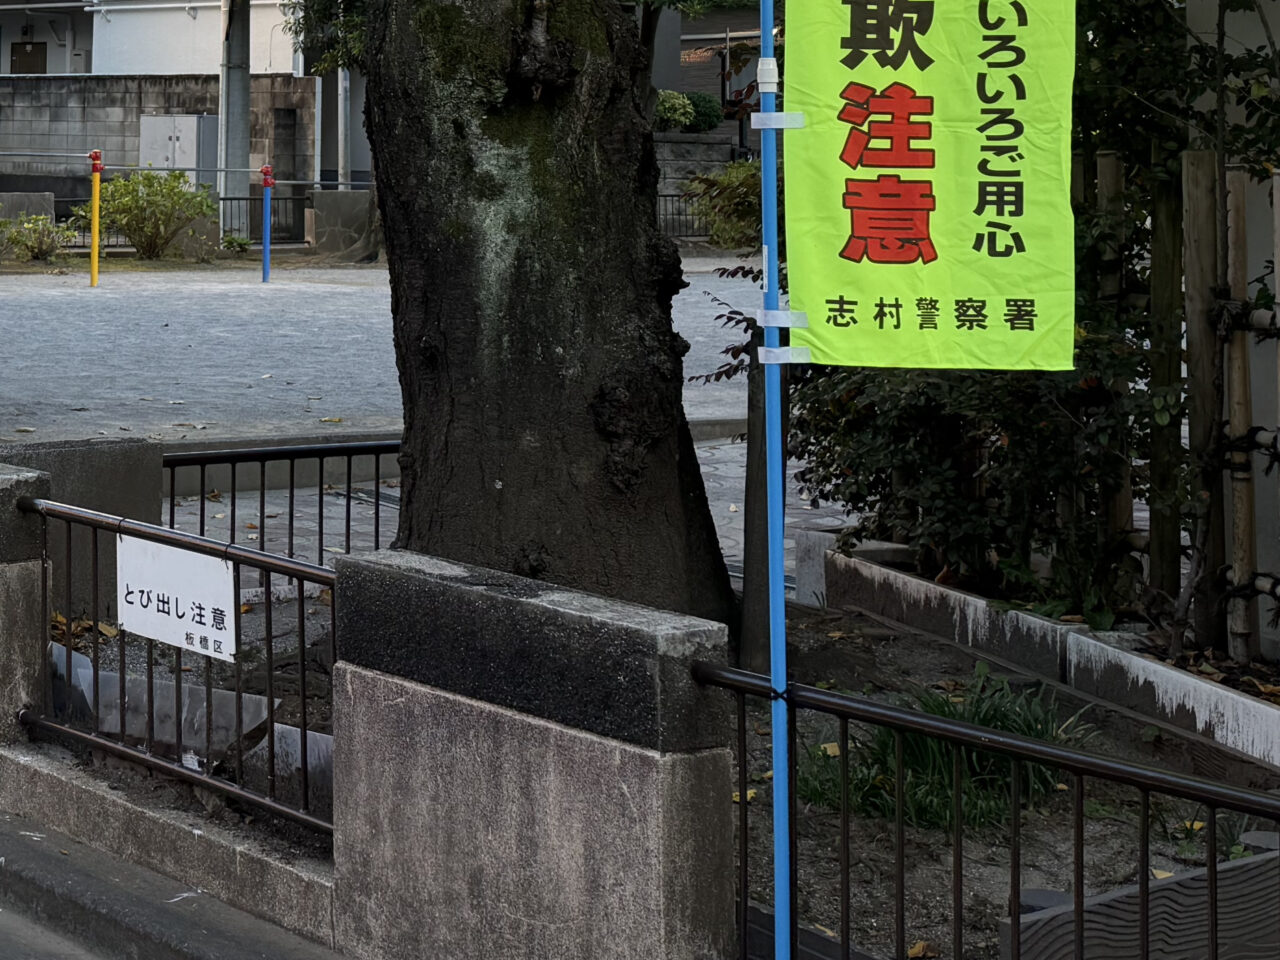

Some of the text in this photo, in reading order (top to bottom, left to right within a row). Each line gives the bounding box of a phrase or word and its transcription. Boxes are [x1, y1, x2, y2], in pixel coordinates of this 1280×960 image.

[824, 295, 1038, 332] 志村警察署
[124, 583, 227, 631] とび出し注意
[184, 632, 224, 654] 板橋区
